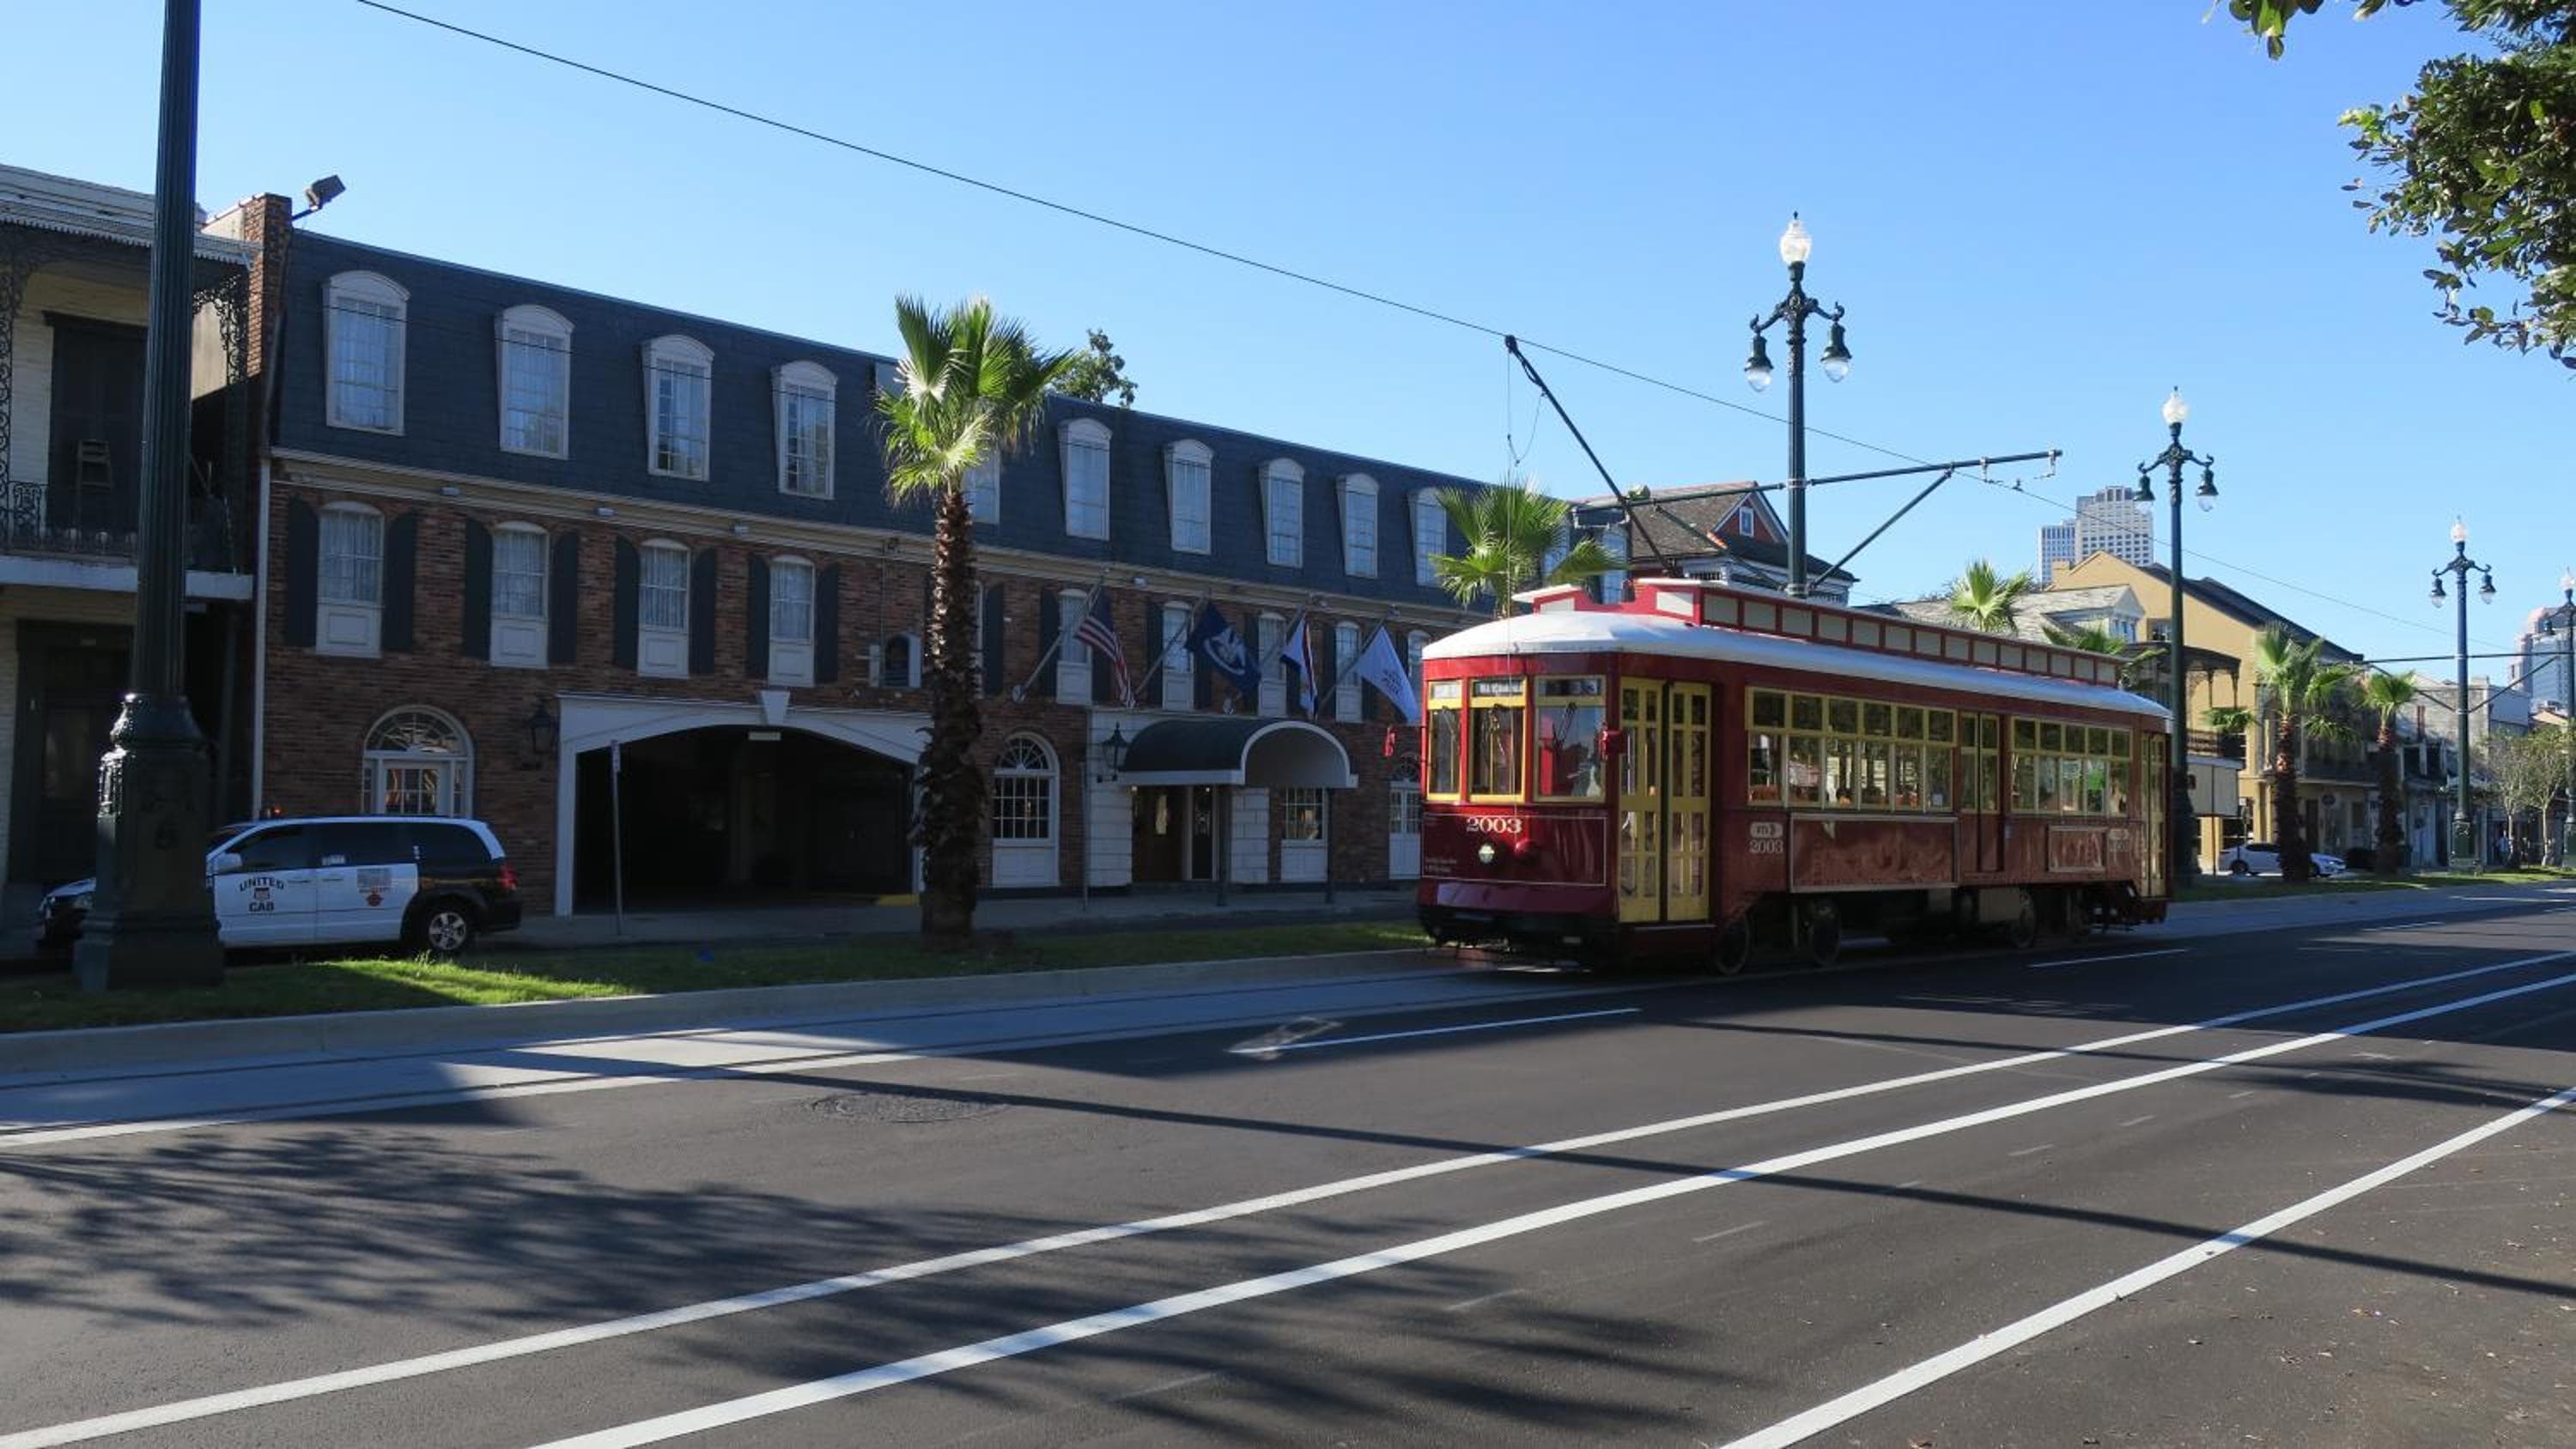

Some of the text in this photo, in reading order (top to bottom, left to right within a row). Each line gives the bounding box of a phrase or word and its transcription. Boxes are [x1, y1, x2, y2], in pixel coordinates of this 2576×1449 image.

[1466, 817, 1522, 833] 2003
[1749, 839, 1783, 853] 2003
[240, 876, 285, 892] UNITED
[248, 901, 275, 912] CAB
